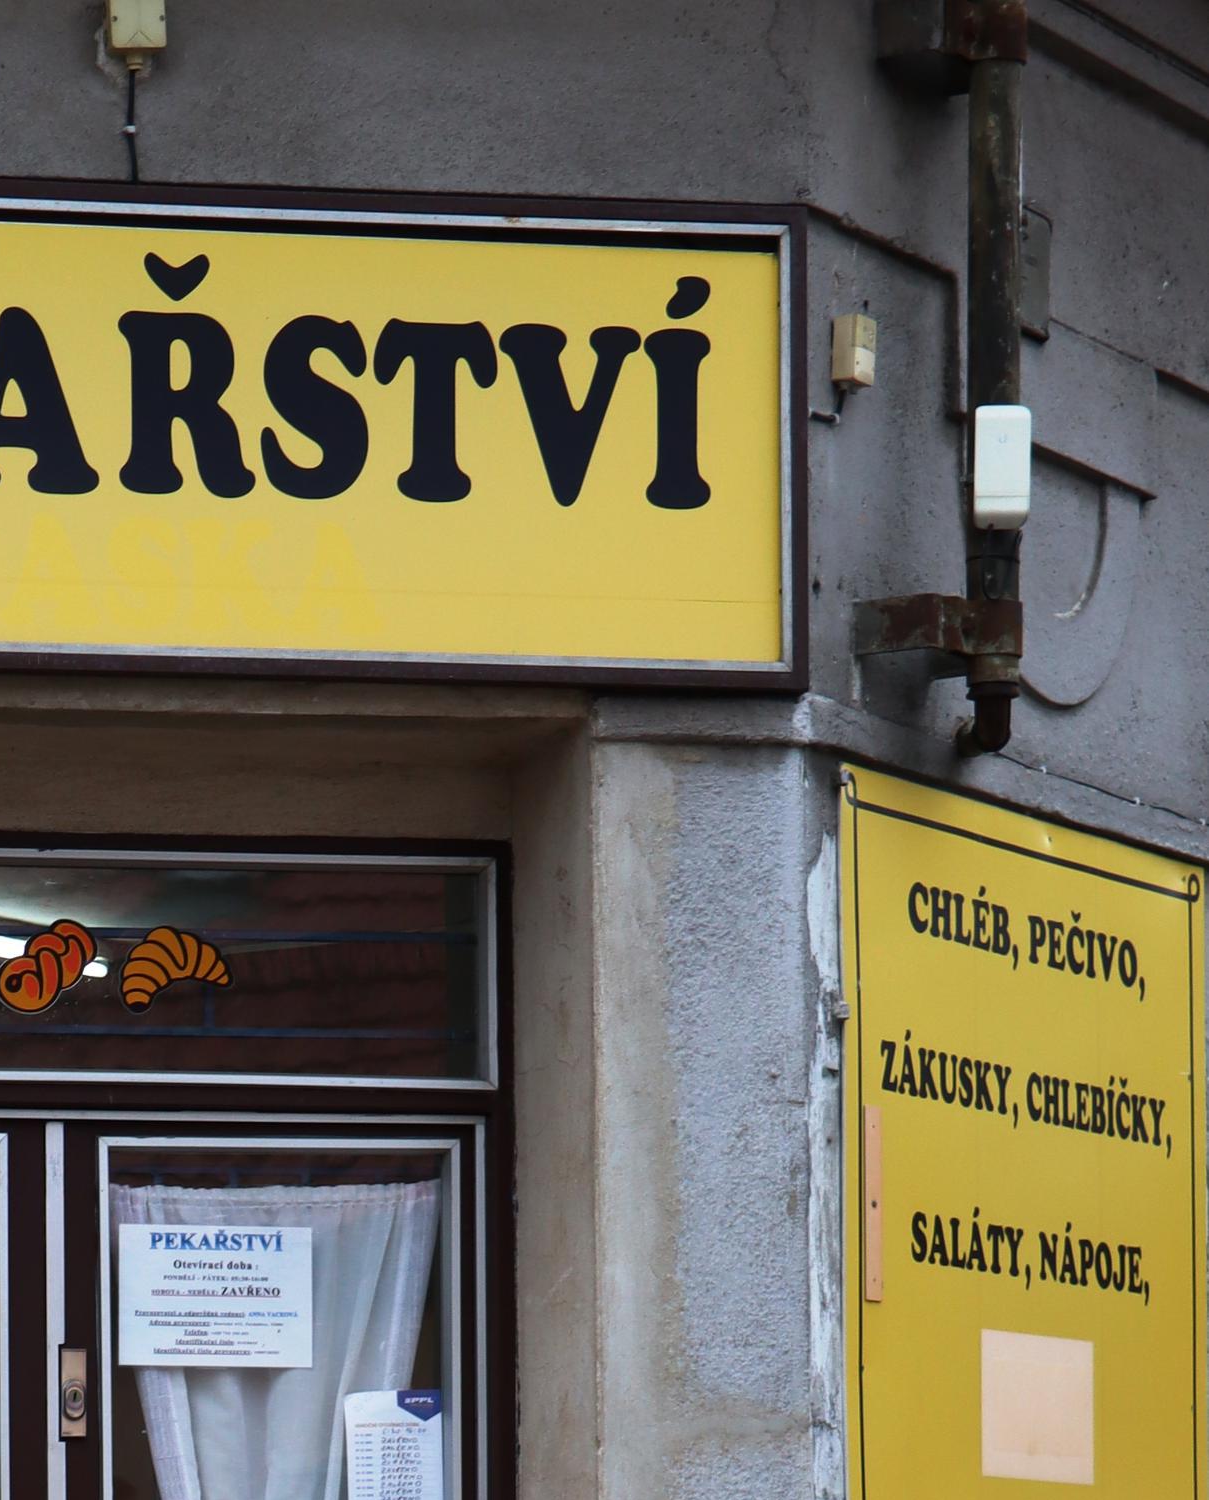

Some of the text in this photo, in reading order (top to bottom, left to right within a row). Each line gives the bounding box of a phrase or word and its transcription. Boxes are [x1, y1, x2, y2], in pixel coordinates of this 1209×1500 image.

[908, 882, 1145, 1001] CHLÉB, PEČIVO,
[880, 1030, 1171, 1158] ZÁKUSKY, CHLEBÍČKY,
[149, 1229, 283, 1251] PEKAŘSTVÍ
[173, 1259, 224, 1270] Otevírací
[226, 1261, 252, 1270] doba
[911, 1207, 1150, 1306] SALÁTY, NÁPOJE,
[221, 1285, 281, 1297] ZAVŘENO
